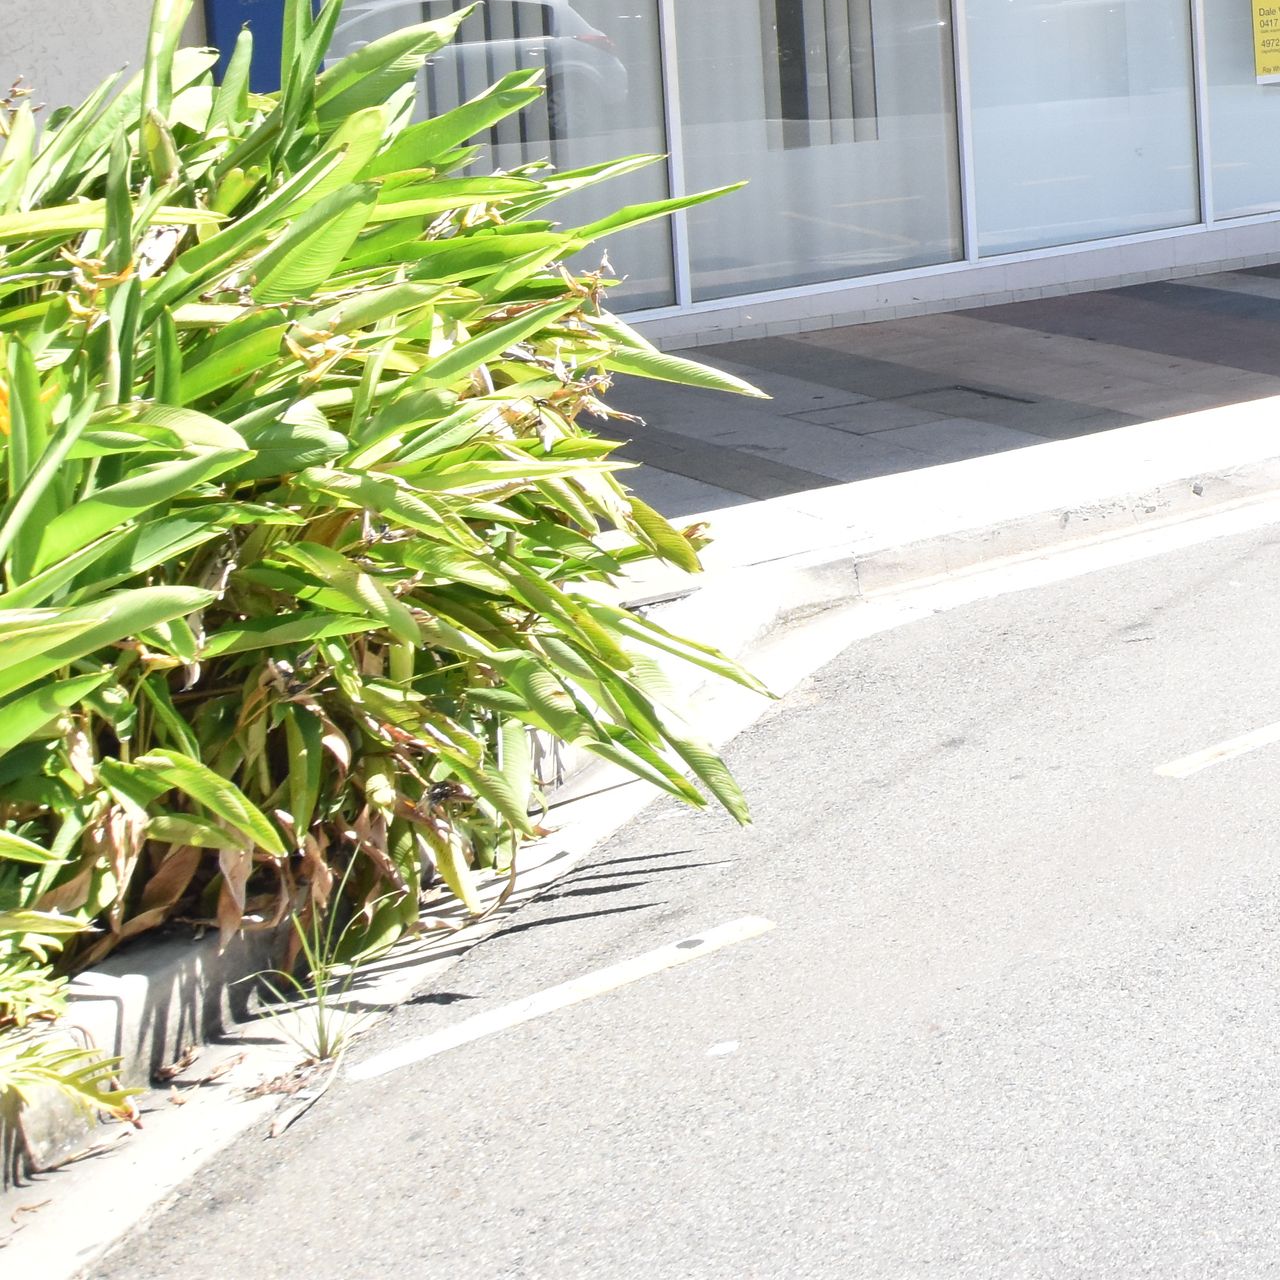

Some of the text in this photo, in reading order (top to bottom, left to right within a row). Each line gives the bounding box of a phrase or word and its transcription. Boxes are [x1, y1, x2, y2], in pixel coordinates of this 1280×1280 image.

[1259, 7, 1276, 17] Dale
[1260, 19, 1278, 28] 0417
[1261, 38, 1280, 48] 4972
